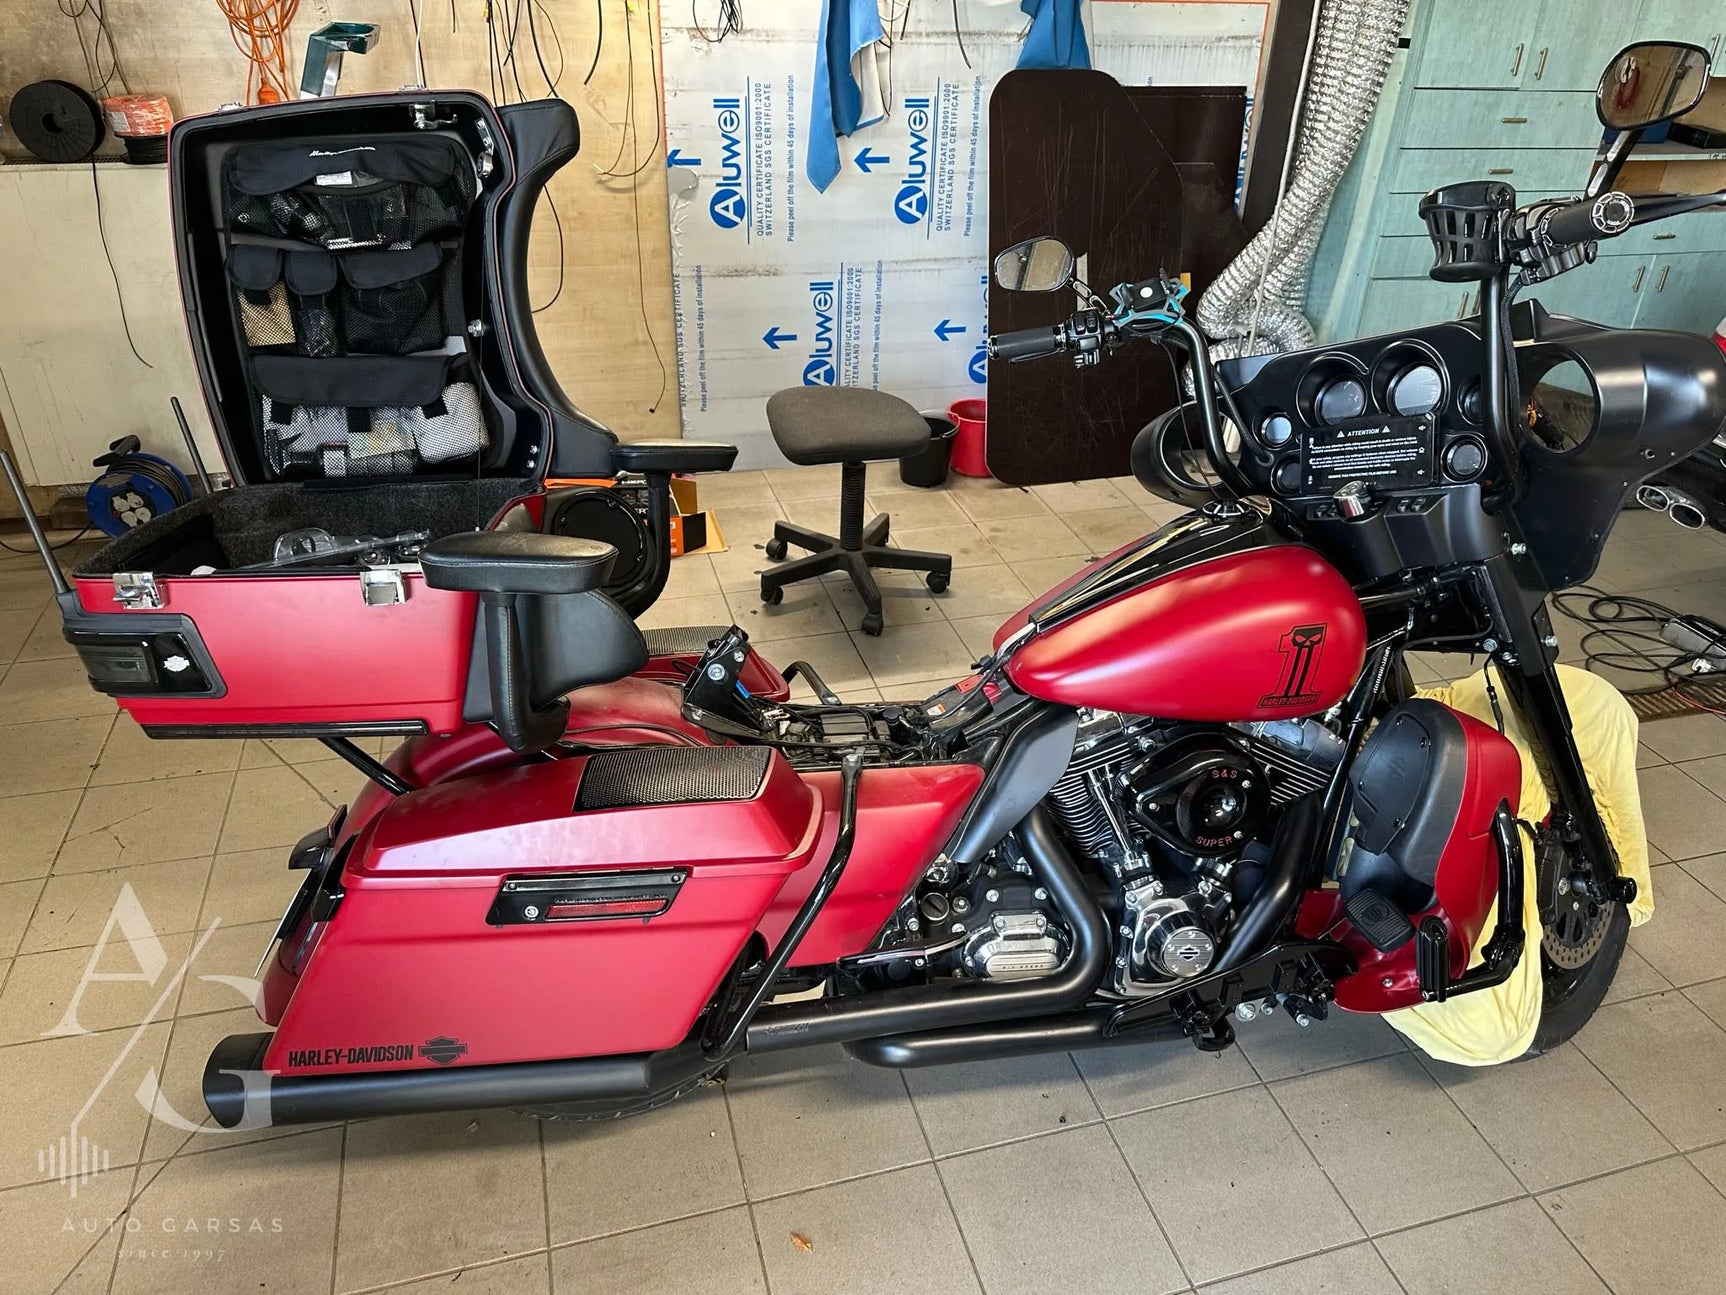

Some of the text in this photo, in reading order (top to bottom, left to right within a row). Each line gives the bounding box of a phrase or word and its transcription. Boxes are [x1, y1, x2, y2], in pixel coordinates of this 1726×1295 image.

[973, 76, 981, 112] installation
[787, 122, 795, 138] days
[787, 140, 794, 148] 45
[971, 121, 979, 137] days
[971, 138, 977, 146] 45
[710, 98, 746, 229] Aluwell
[755, 144, 763, 198] CERTIFICATE
[894, 98, 929, 224] Aluwell
[936, 83, 950, 231] QUALITY CERTIFICATE ISO9001:2000
[944, 84, 959, 231] SWITZERLAND SGS CERTIFICATE
[756, 201, 764, 236] QUALITY
[964, 217, 972, 236] Please
[695, 265, 703, 299] installation
[854, 268, 862, 321] CERTIFICATE
[696, 307, 704, 321] days
[803, 282, 835, 386] Aluwell
[845, 320, 853, 367] CERTIFICATE
[852, 344, 860, 387] ITZERLAND
[1347, 428, 1380, 437] ATTENTION
[1211, 769, 1238, 779] S&S
[1195, 835, 1233, 847] SUPER
[288, 1045, 414, 1067] HARLEY-DAVIDSON
